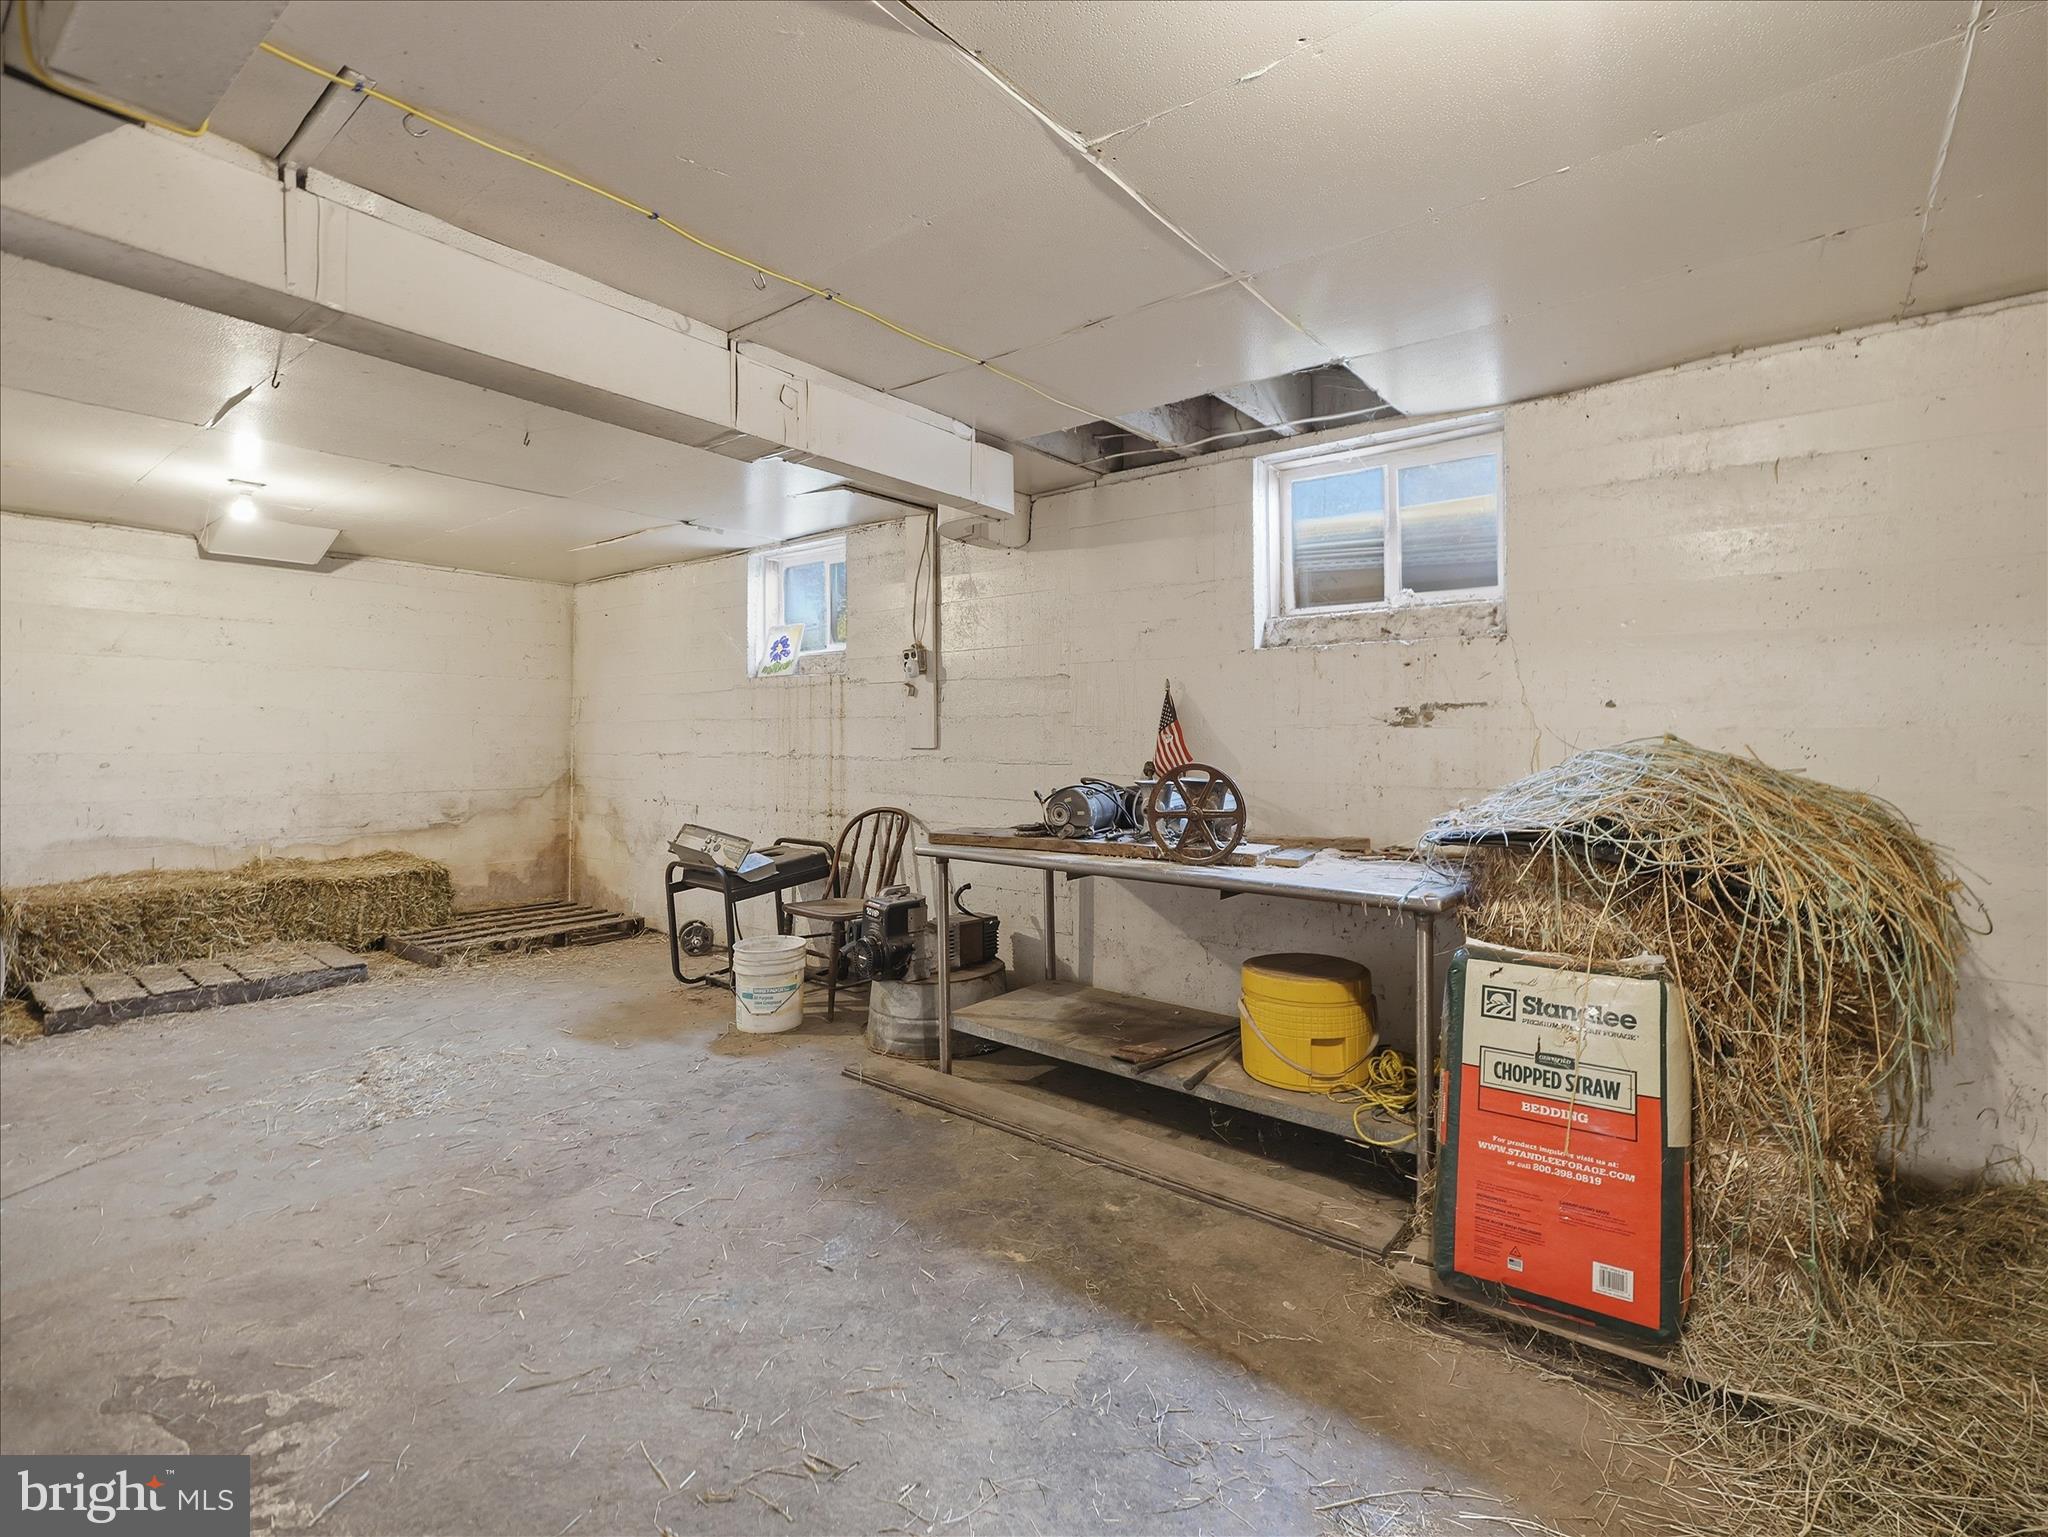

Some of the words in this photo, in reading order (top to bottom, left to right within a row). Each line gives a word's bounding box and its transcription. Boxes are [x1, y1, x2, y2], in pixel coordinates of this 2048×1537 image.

[1493, 1060, 1562, 1090] CHOPPED
[1565, 1073, 1621, 1101] STRAW
[1520, 1101, 1590, 1124] BEDDING
[1477, 1139, 1636, 1183] WWW.STANDLEEFORAGE.COM
[1492, 1135, 1506, 1144] For
[1507, 1138, 1537, 1151] product
[1576, 1152, 1594, 1163] visit
[1517, 1161, 1532, 1170] call
